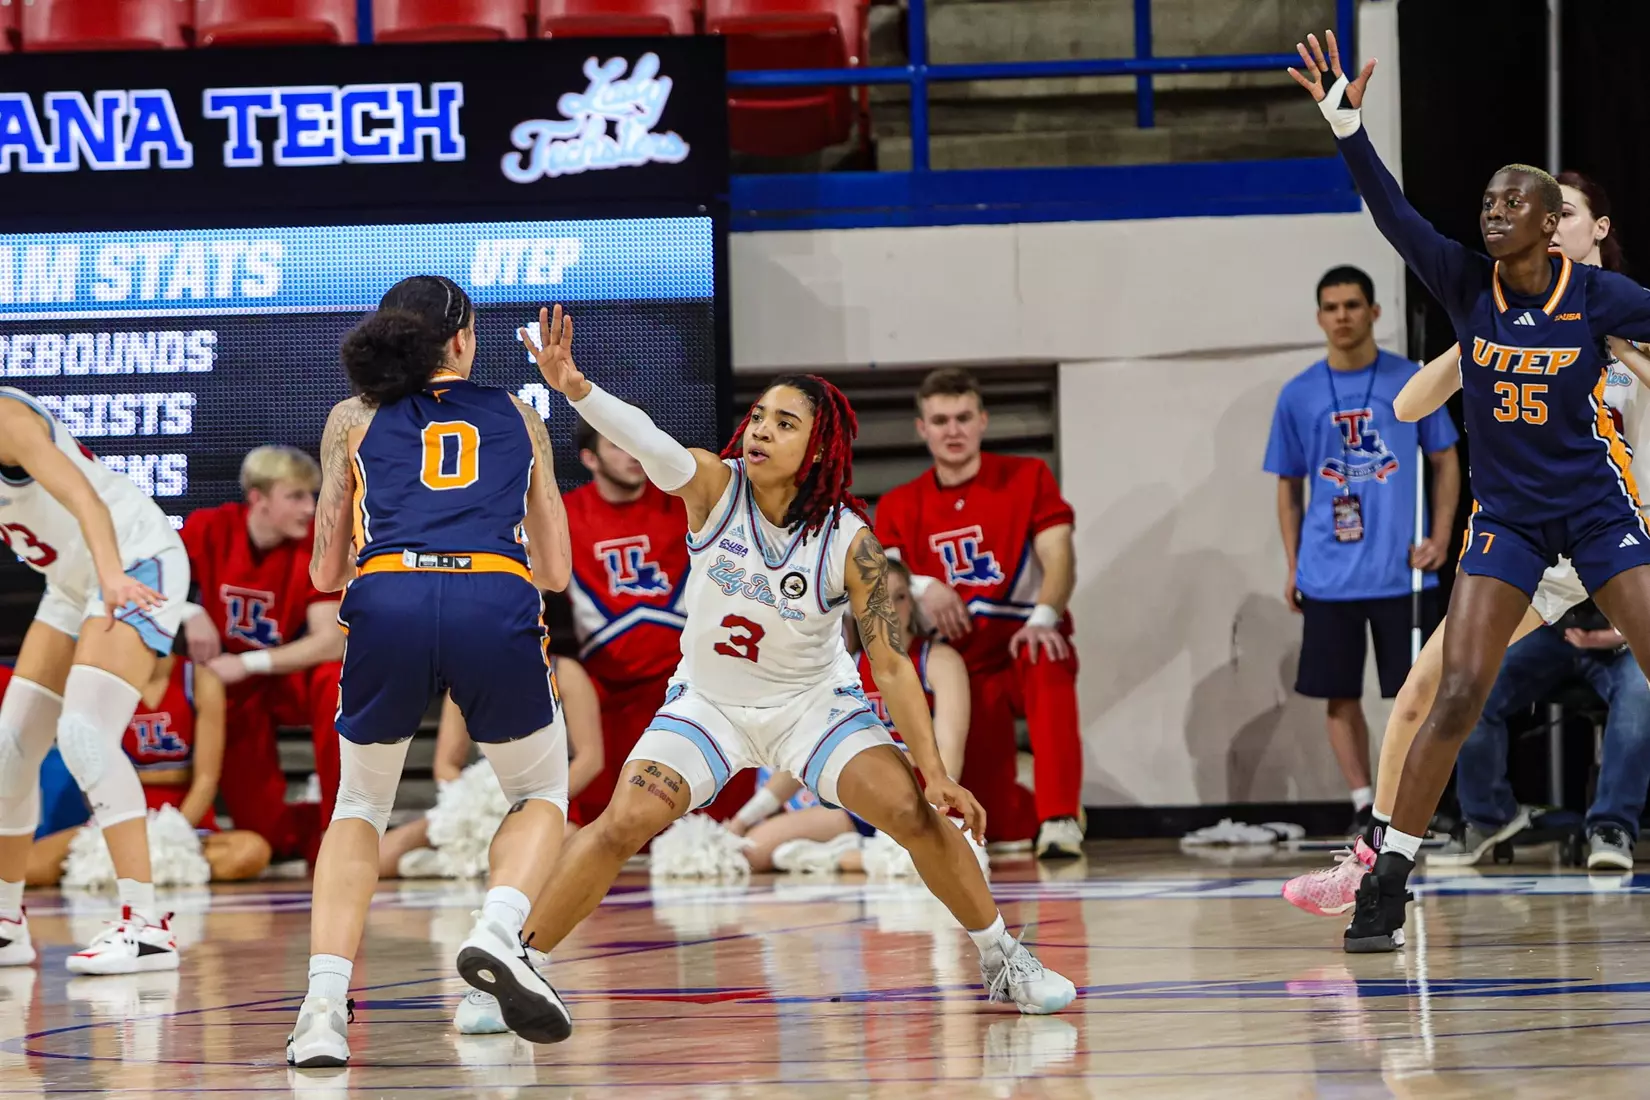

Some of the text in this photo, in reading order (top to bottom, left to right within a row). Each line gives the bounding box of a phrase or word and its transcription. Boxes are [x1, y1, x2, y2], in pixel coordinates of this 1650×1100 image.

[203, 82, 465, 168] TECH
[93, 239, 283, 301] STATS
[470, 237, 582, 286] UTEP
[1472, 335, 1582, 376] UTEP
[1493, 381, 1549, 425] 35
[420, 420, 480, 490] 0
[707, 555, 746, 596] Lady
[713, 613, 766, 663] 3
